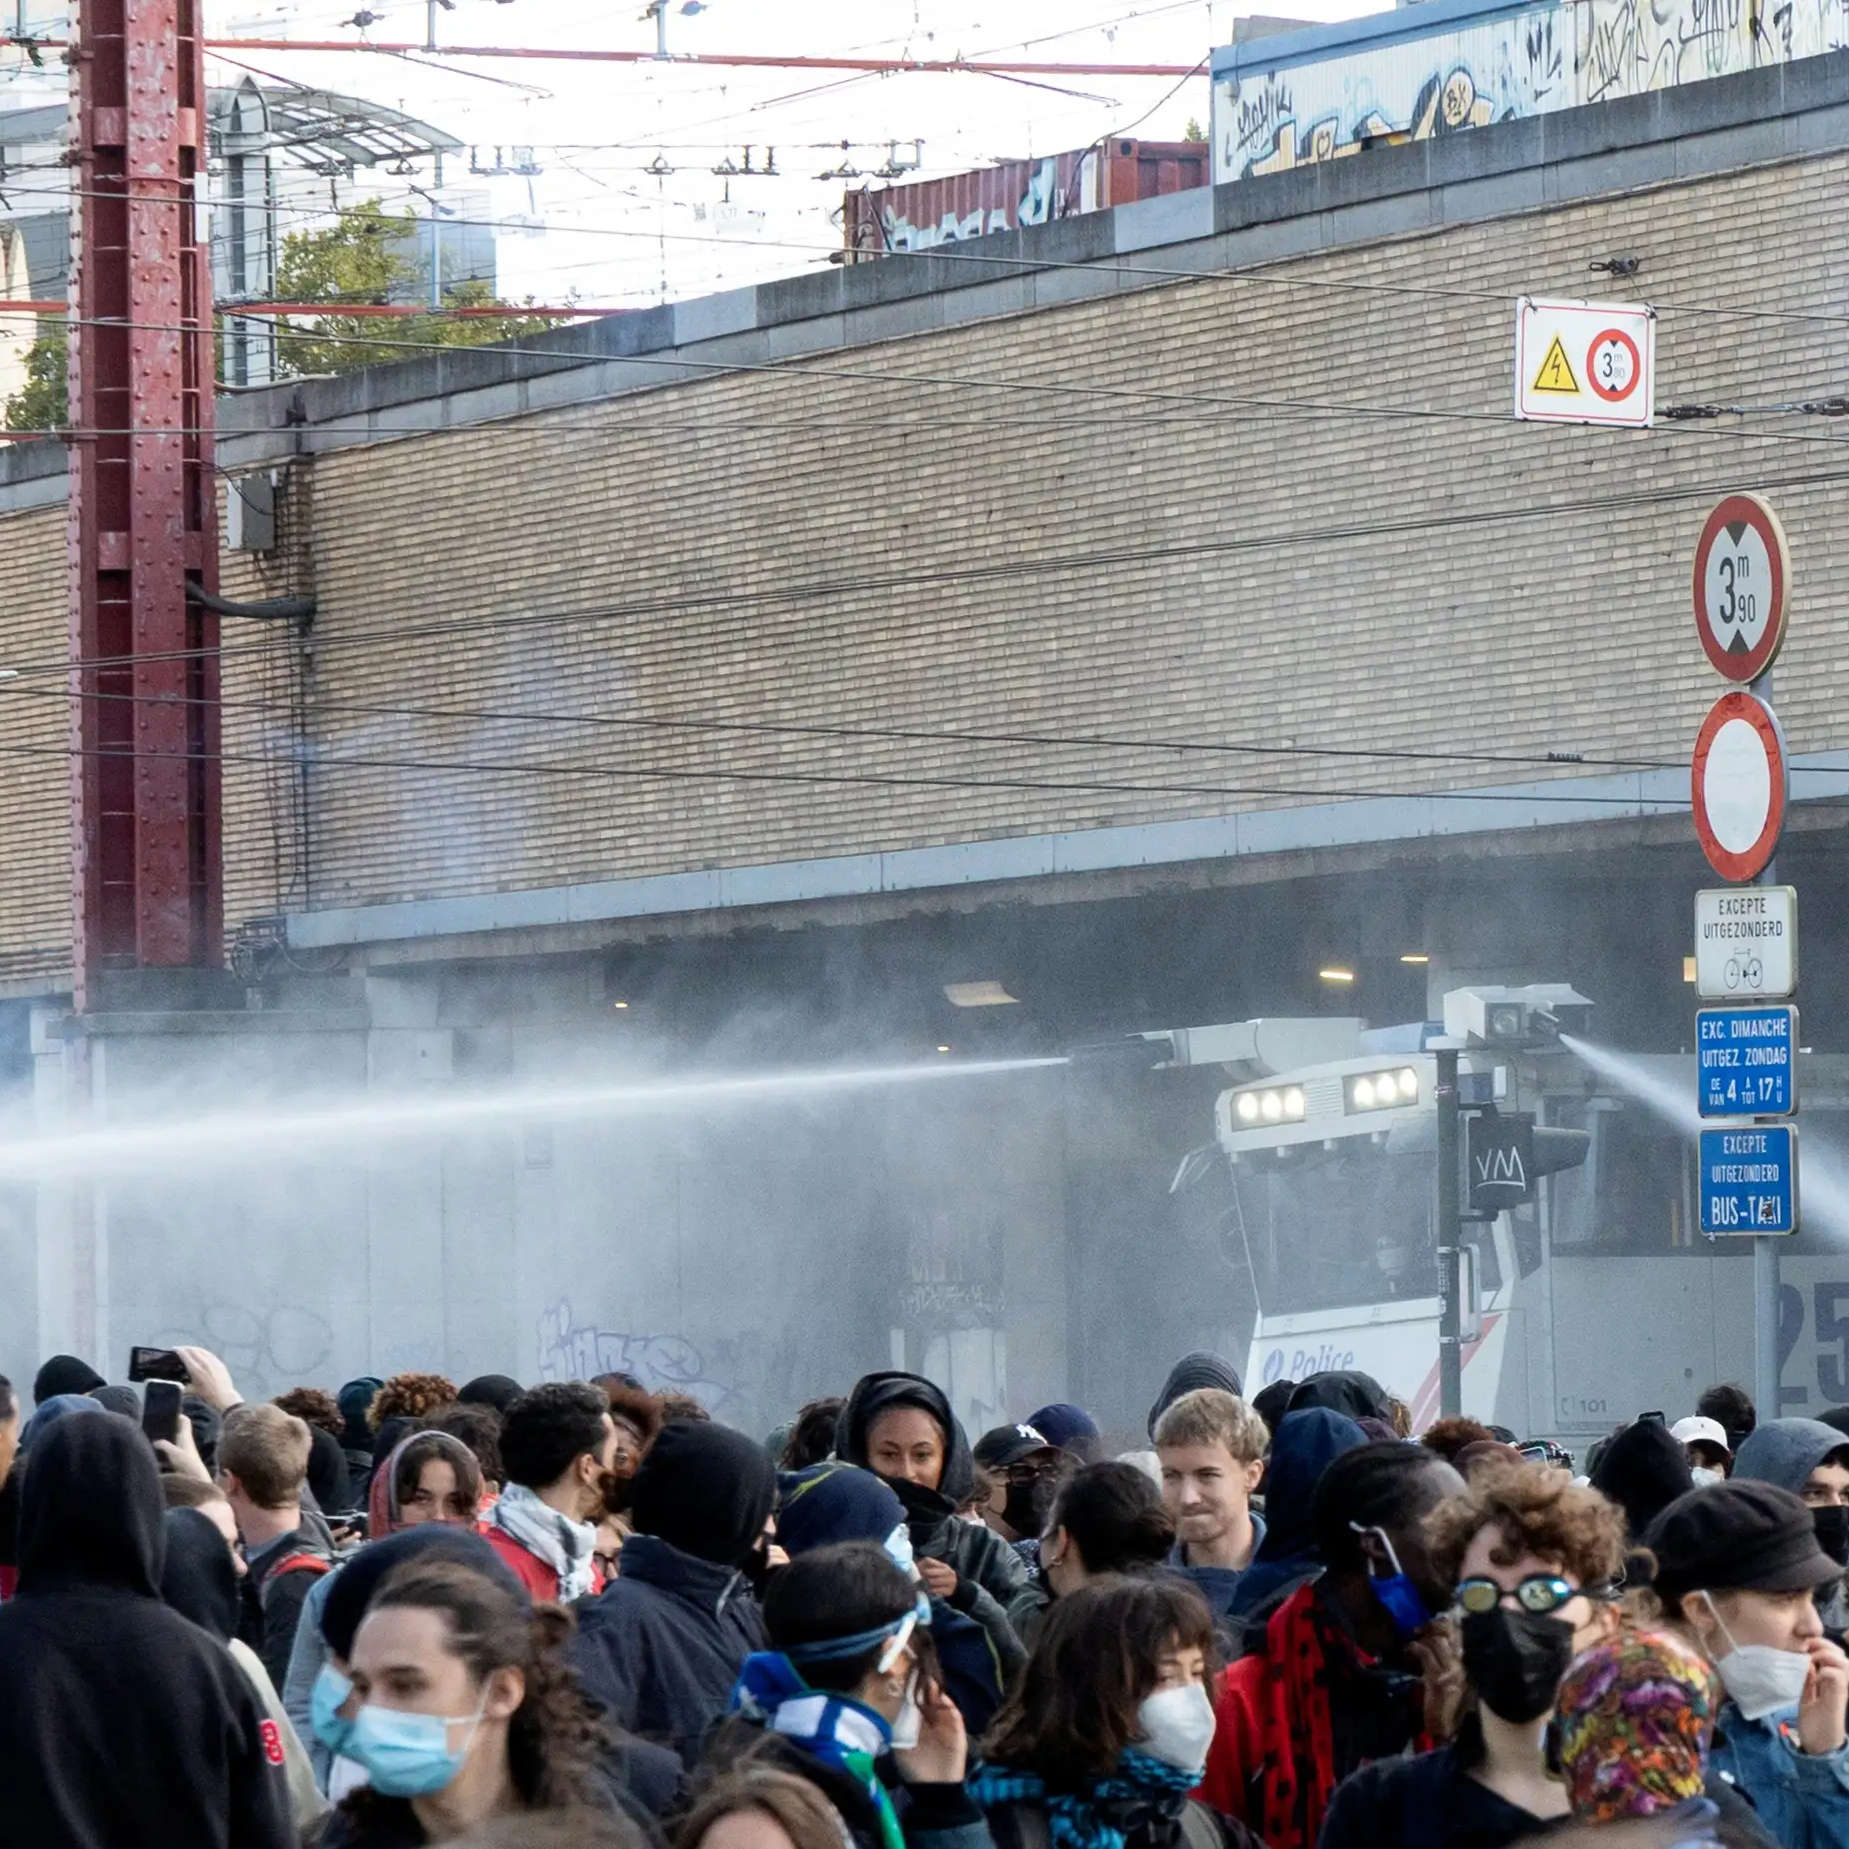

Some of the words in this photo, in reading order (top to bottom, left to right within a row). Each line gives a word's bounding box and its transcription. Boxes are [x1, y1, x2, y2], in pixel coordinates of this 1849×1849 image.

[1603, 352, 1613, 378] 3
[1737, 555, 1750, 578] m
[1719, 557, 1737, 625] 3
[1738, 594, 1757, 624] 90
[1718, 897, 1767, 916] EXCEPTE
[1703, 920, 1783, 940] UITGEZONDERD
[1731, 1017, 1788, 1039] DIMANCHE
[1745, 1046, 1788, 1066] ZONDAG
[1708, 1092, 1725, 1107] VAN
[1741, 1091, 1756, 1105] TOT
[1710, 1077, 1722, 1091] DE
[1726, 1080, 1737, 1103] 4
[1758, 1078, 1774, 1102] 17
[1723, 1135, 1768, 1155] EXCEPTE
[1711, 1163, 1780, 1183] UITGEZONDERD
[1289, 1344, 1355, 1379] Police
[1580, 1399, 1608, 1414] 101
